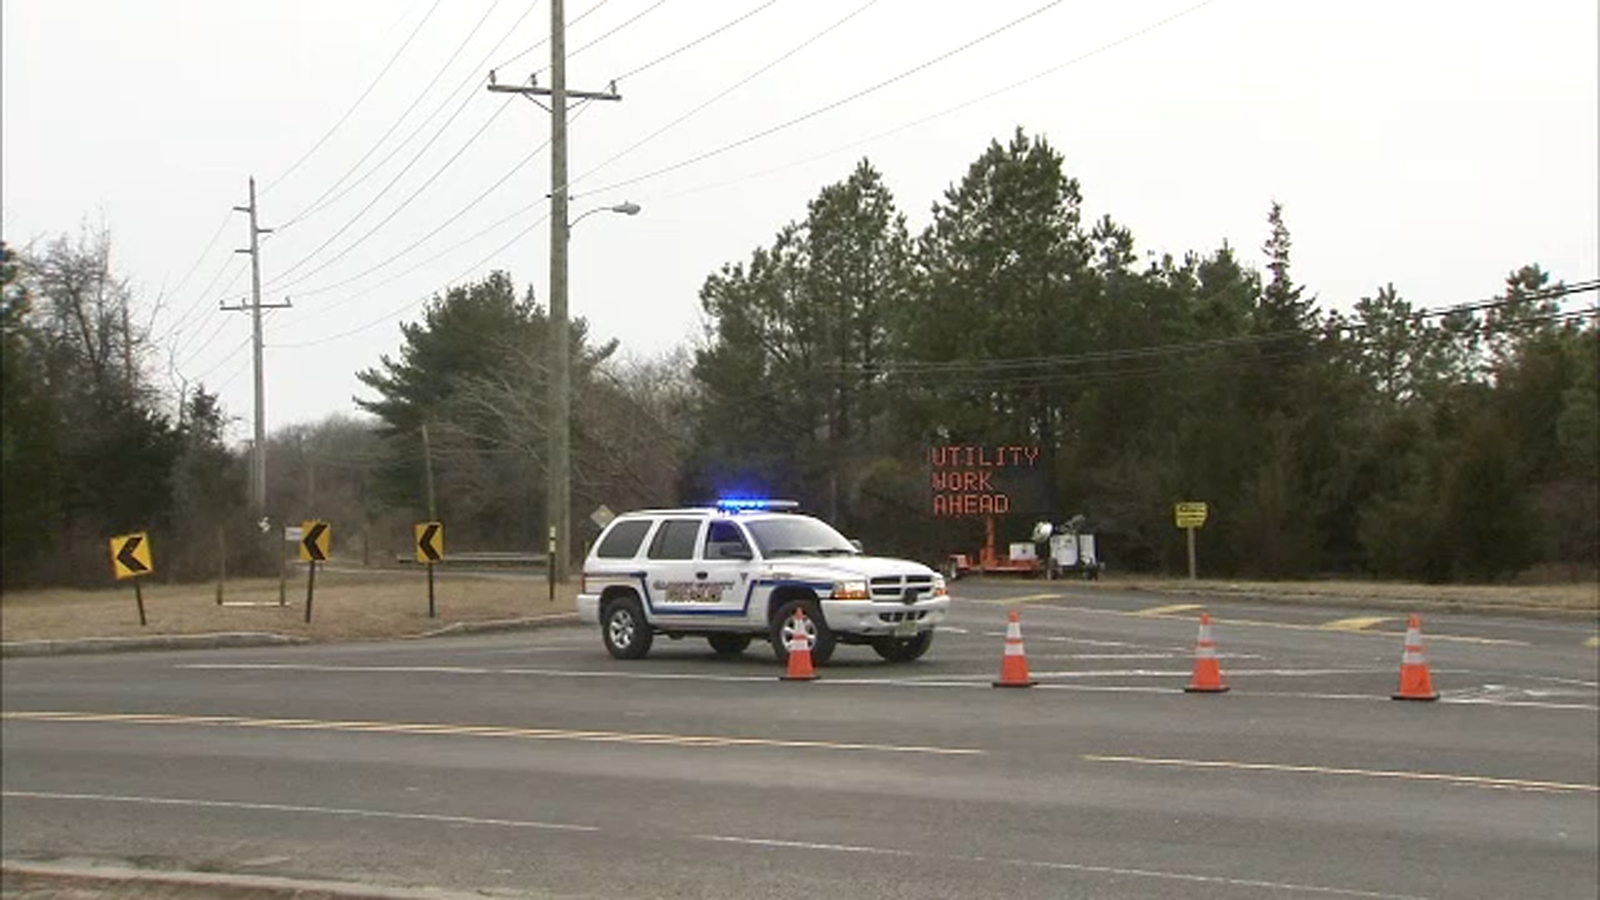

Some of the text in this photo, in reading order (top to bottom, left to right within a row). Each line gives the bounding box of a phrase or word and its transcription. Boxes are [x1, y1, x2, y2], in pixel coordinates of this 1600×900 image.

[931, 446, 1039, 466] UTILITY
[932, 471, 993, 491] WORK
[934, 494, 1009, 514] AHEAD
